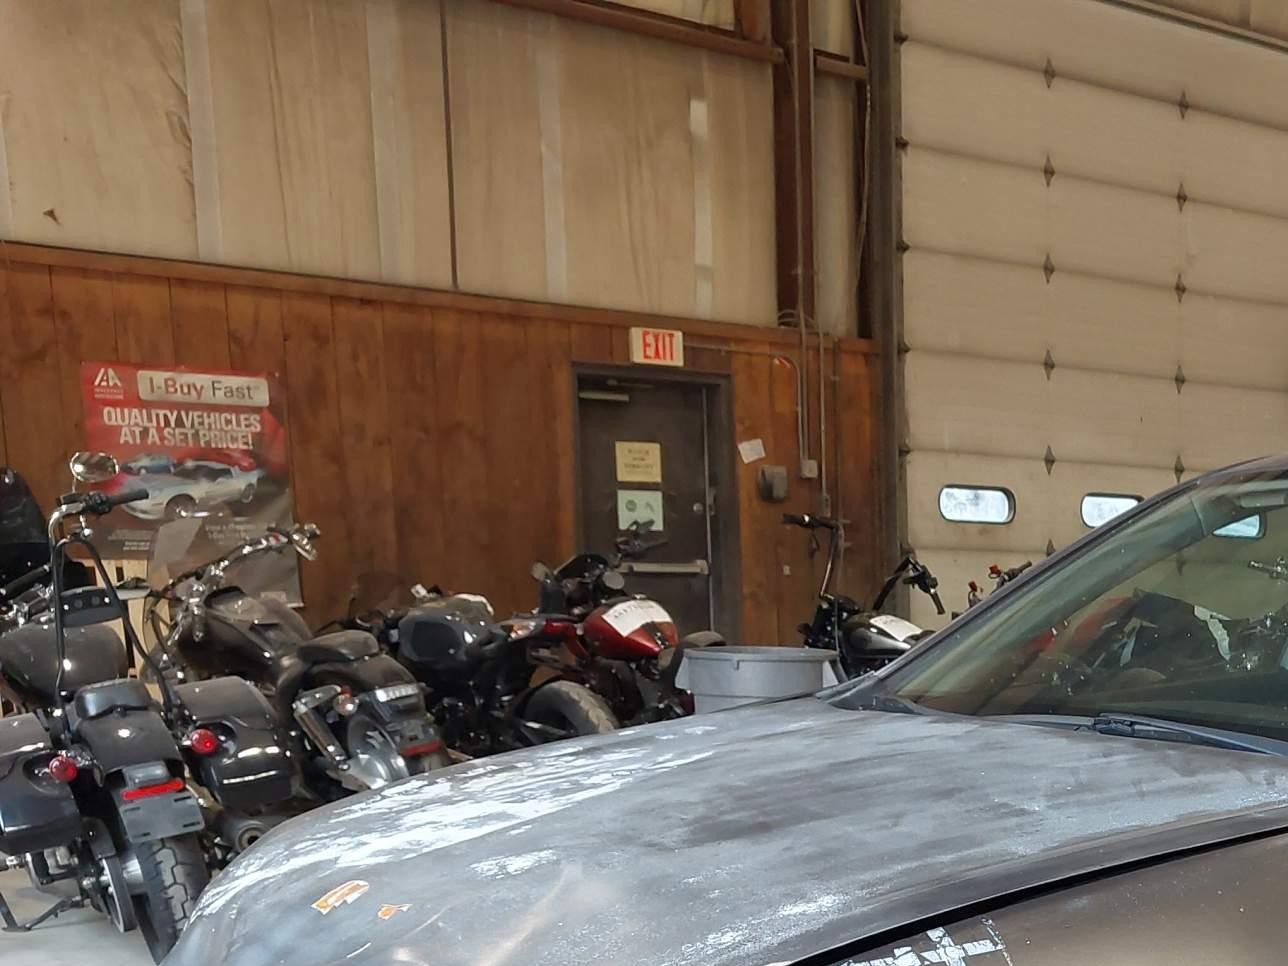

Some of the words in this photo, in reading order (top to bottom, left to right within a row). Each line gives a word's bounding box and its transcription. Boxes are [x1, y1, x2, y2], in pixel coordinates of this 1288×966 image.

[641, 330, 675, 362] EXIT
[149, 376, 204, 400] I-Buy
[211, 380, 254, 400] Fast
[103, 406, 178, 428] QUALITY
[181, 411, 261, 432] VEHICLES
[119, 427, 143, 445] AT
[147, 428, 160, 445] A
[163, 429, 195, 448] SET
[200, 430, 253, 450] PRICE!
